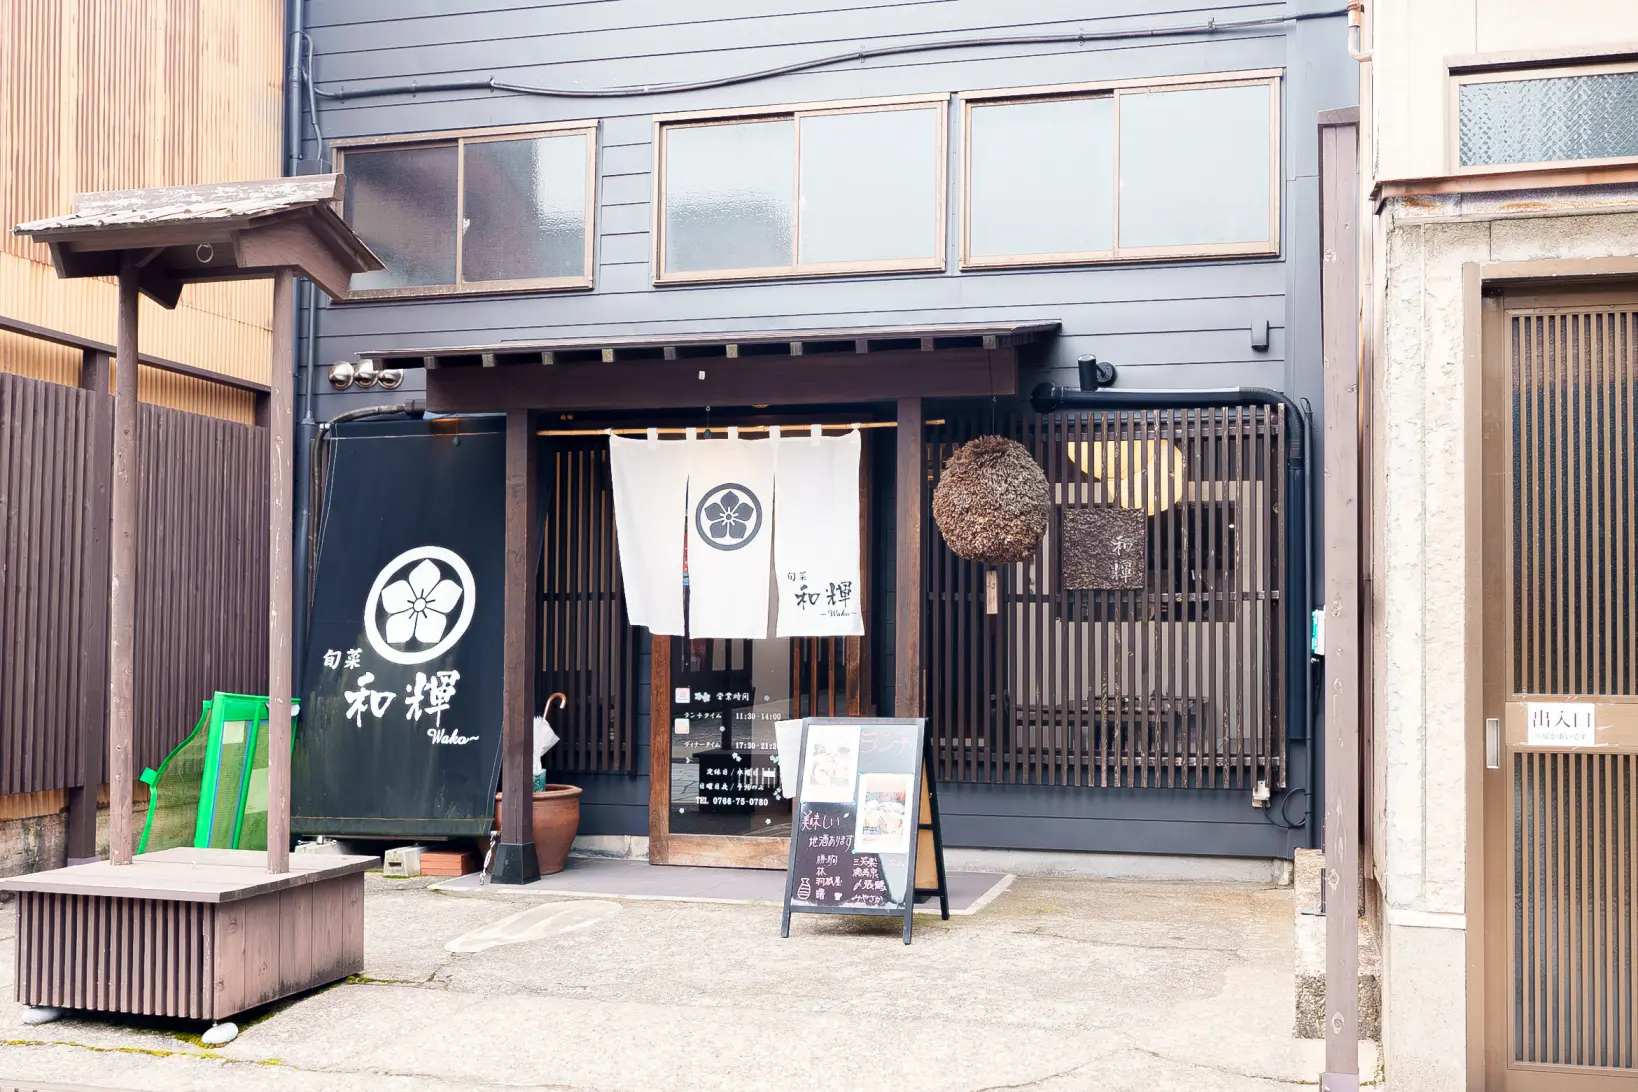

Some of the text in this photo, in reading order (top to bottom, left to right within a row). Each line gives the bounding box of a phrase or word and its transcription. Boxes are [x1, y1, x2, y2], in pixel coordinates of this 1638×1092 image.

[1110, 535, 1134, 583] 和輝
[795, 581, 853, 610] 和輝
[323, 648, 363, 671] 旬菜
[344, 670, 460, 728] 和輝
[716, 692, 750, 702] 営業時間
[1533, 709, 1591, 728] 出入口
[695, 797, 709, 805] TEL
[802, 810, 841, 832] 美味しい
[808, 834, 854, 852] 地酒あります
